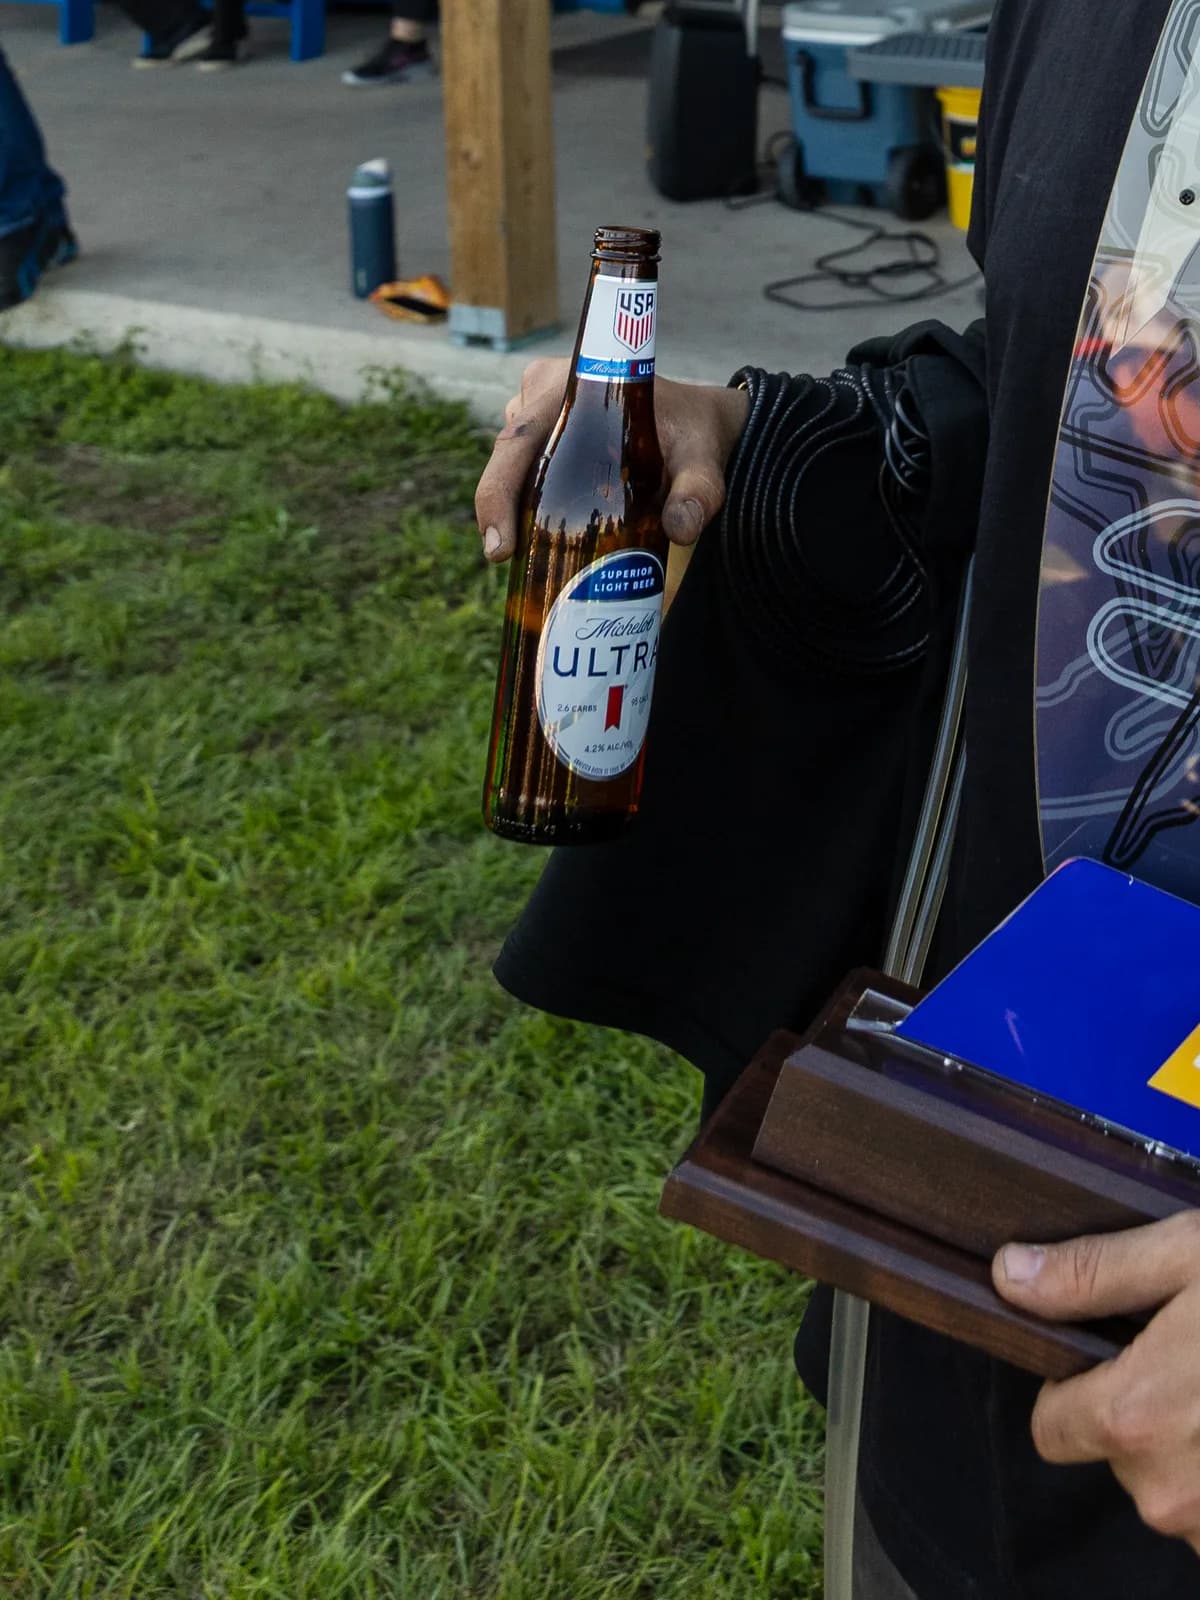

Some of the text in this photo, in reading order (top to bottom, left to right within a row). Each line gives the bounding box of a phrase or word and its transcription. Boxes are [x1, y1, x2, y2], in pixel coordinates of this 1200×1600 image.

[620, 293, 654, 317] USA
[600, 566, 654, 580] SUPERIOR
[594, 578, 655, 593] LIGHT BEER
[575, 611, 656, 641] Michelob
[571, 704, 598, 713] CARBS
[584, 743, 606, 753] 4.2%
